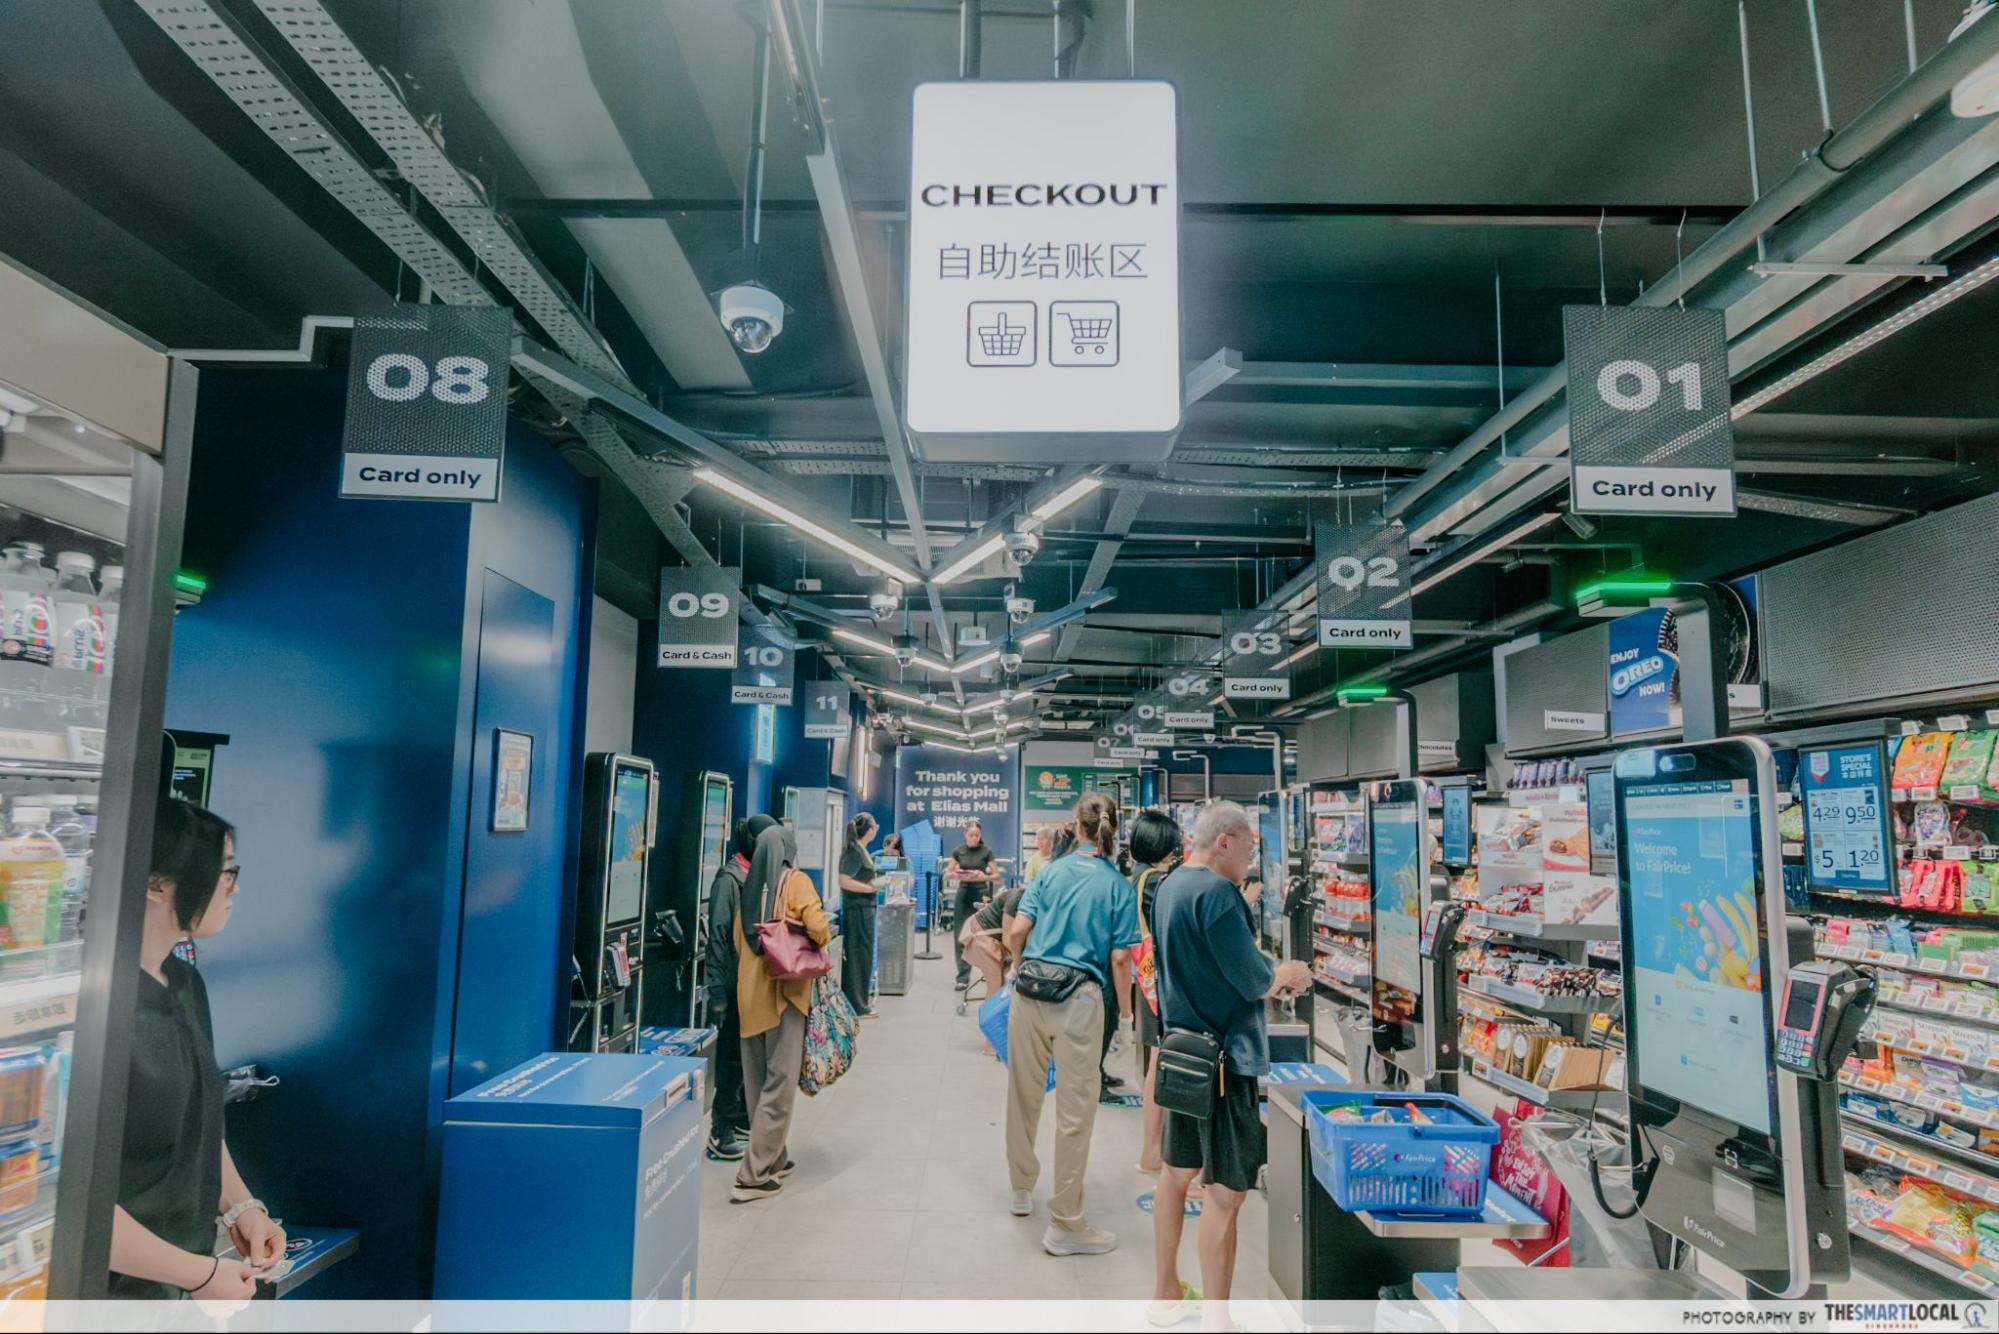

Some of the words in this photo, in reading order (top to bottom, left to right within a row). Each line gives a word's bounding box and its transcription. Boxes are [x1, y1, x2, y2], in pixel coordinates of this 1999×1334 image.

[921, 184, 1168, 207] CHECKOUT
[939, 242, 1148, 280] 自助结账区
[366, 353, 490, 404] 08
[1597, 360, 1702, 411] 01
[358, 466, 420, 485] Card
[425, 468, 482, 488] only
[1592, 480, 1654, 497] Card
[1661, 482, 1717, 503] only
[1328, 556, 1399, 588] 02
[668, 592, 729, 618] 09
[1329, 627, 1366, 638] Card
[1370, 628, 1401, 641] only
[1231, 632, 1282, 655] 03
[662, 651, 690, 659] Card
[692, 651, 699, 660] &
[702, 651, 732, 660] Cash
[744, 646, 784, 666] 10
[1611, 648, 1639, 664] ENJOY
[1612, 656, 1663, 691] OREO
[1168, 678, 1208, 695] 04
[1231, 684, 1257, 692] Card
[1260, 684, 1283, 694] only
[1639, 682, 1665, 697] NOW!
[816, 696, 838, 710] 11
[915, 771, 966, 782] Thank
[970, 773, 1000, 784] you
[906, 785, 930, 796] for
[932, 785, 1009, 799] shopping
[906, 801, 925, 811] at
[931, 800, 971, 812] Elias
[974, 801, 1008, 812] Mall
[1634, 842, 1678, 856] Welcome
[1635, 862, 1645, 871] to
